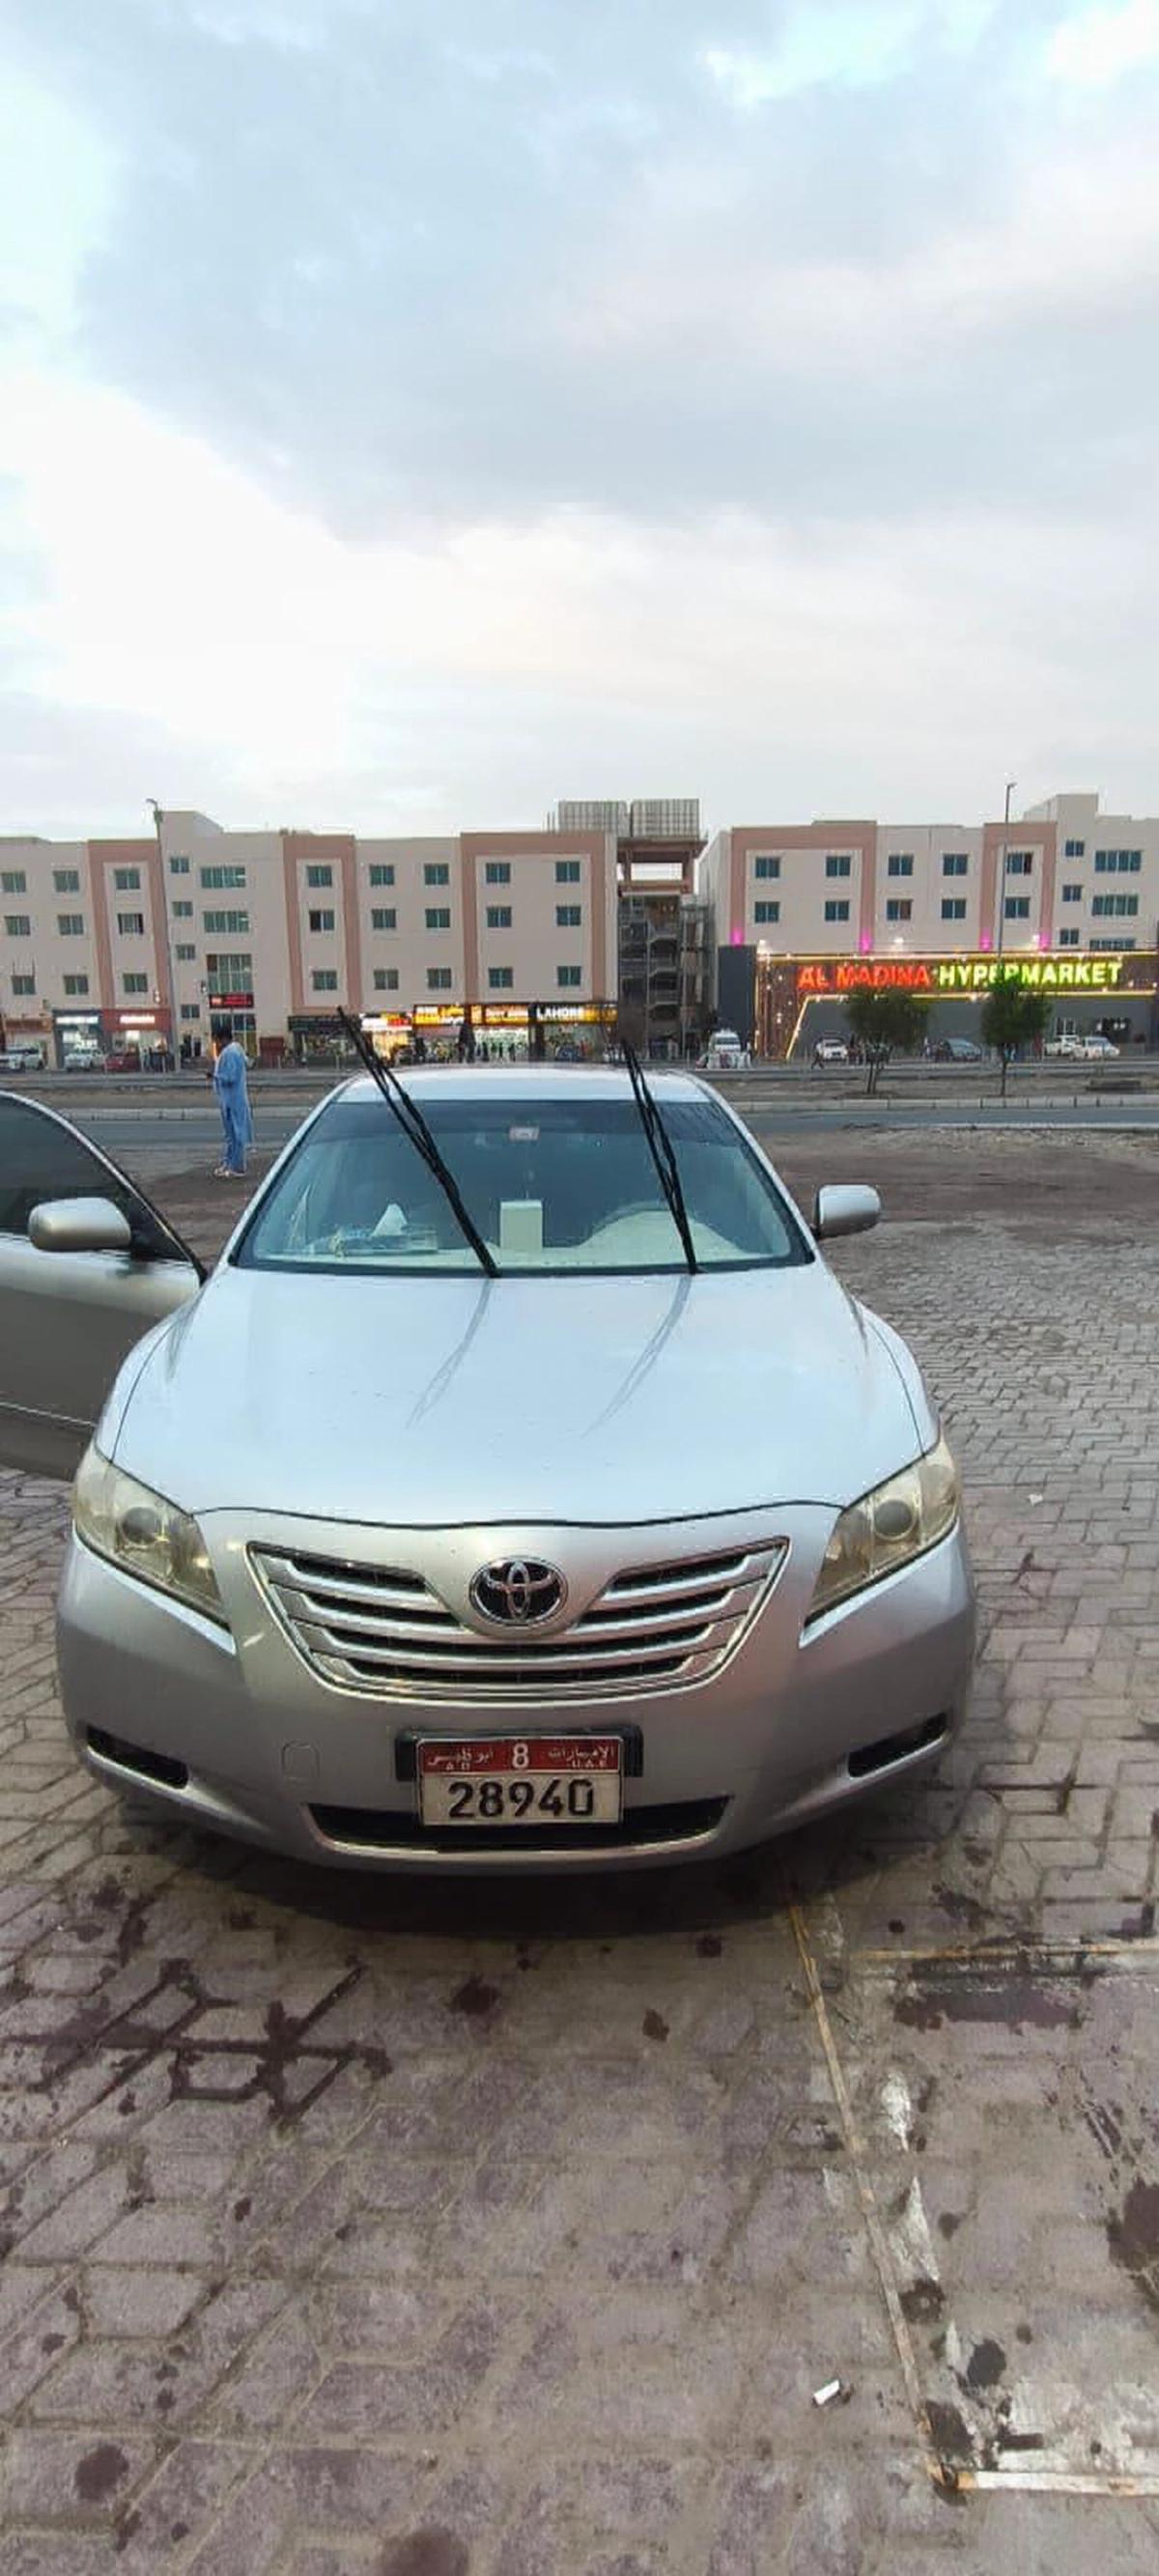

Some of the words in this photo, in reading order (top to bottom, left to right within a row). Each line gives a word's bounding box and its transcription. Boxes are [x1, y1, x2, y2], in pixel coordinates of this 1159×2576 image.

[798, 968, 829, 989] AL
[835, 967, 929, 988] MADINA
[511, 1742, 529, 1769] 8
[448, 1778, 594, 1819] 28940
